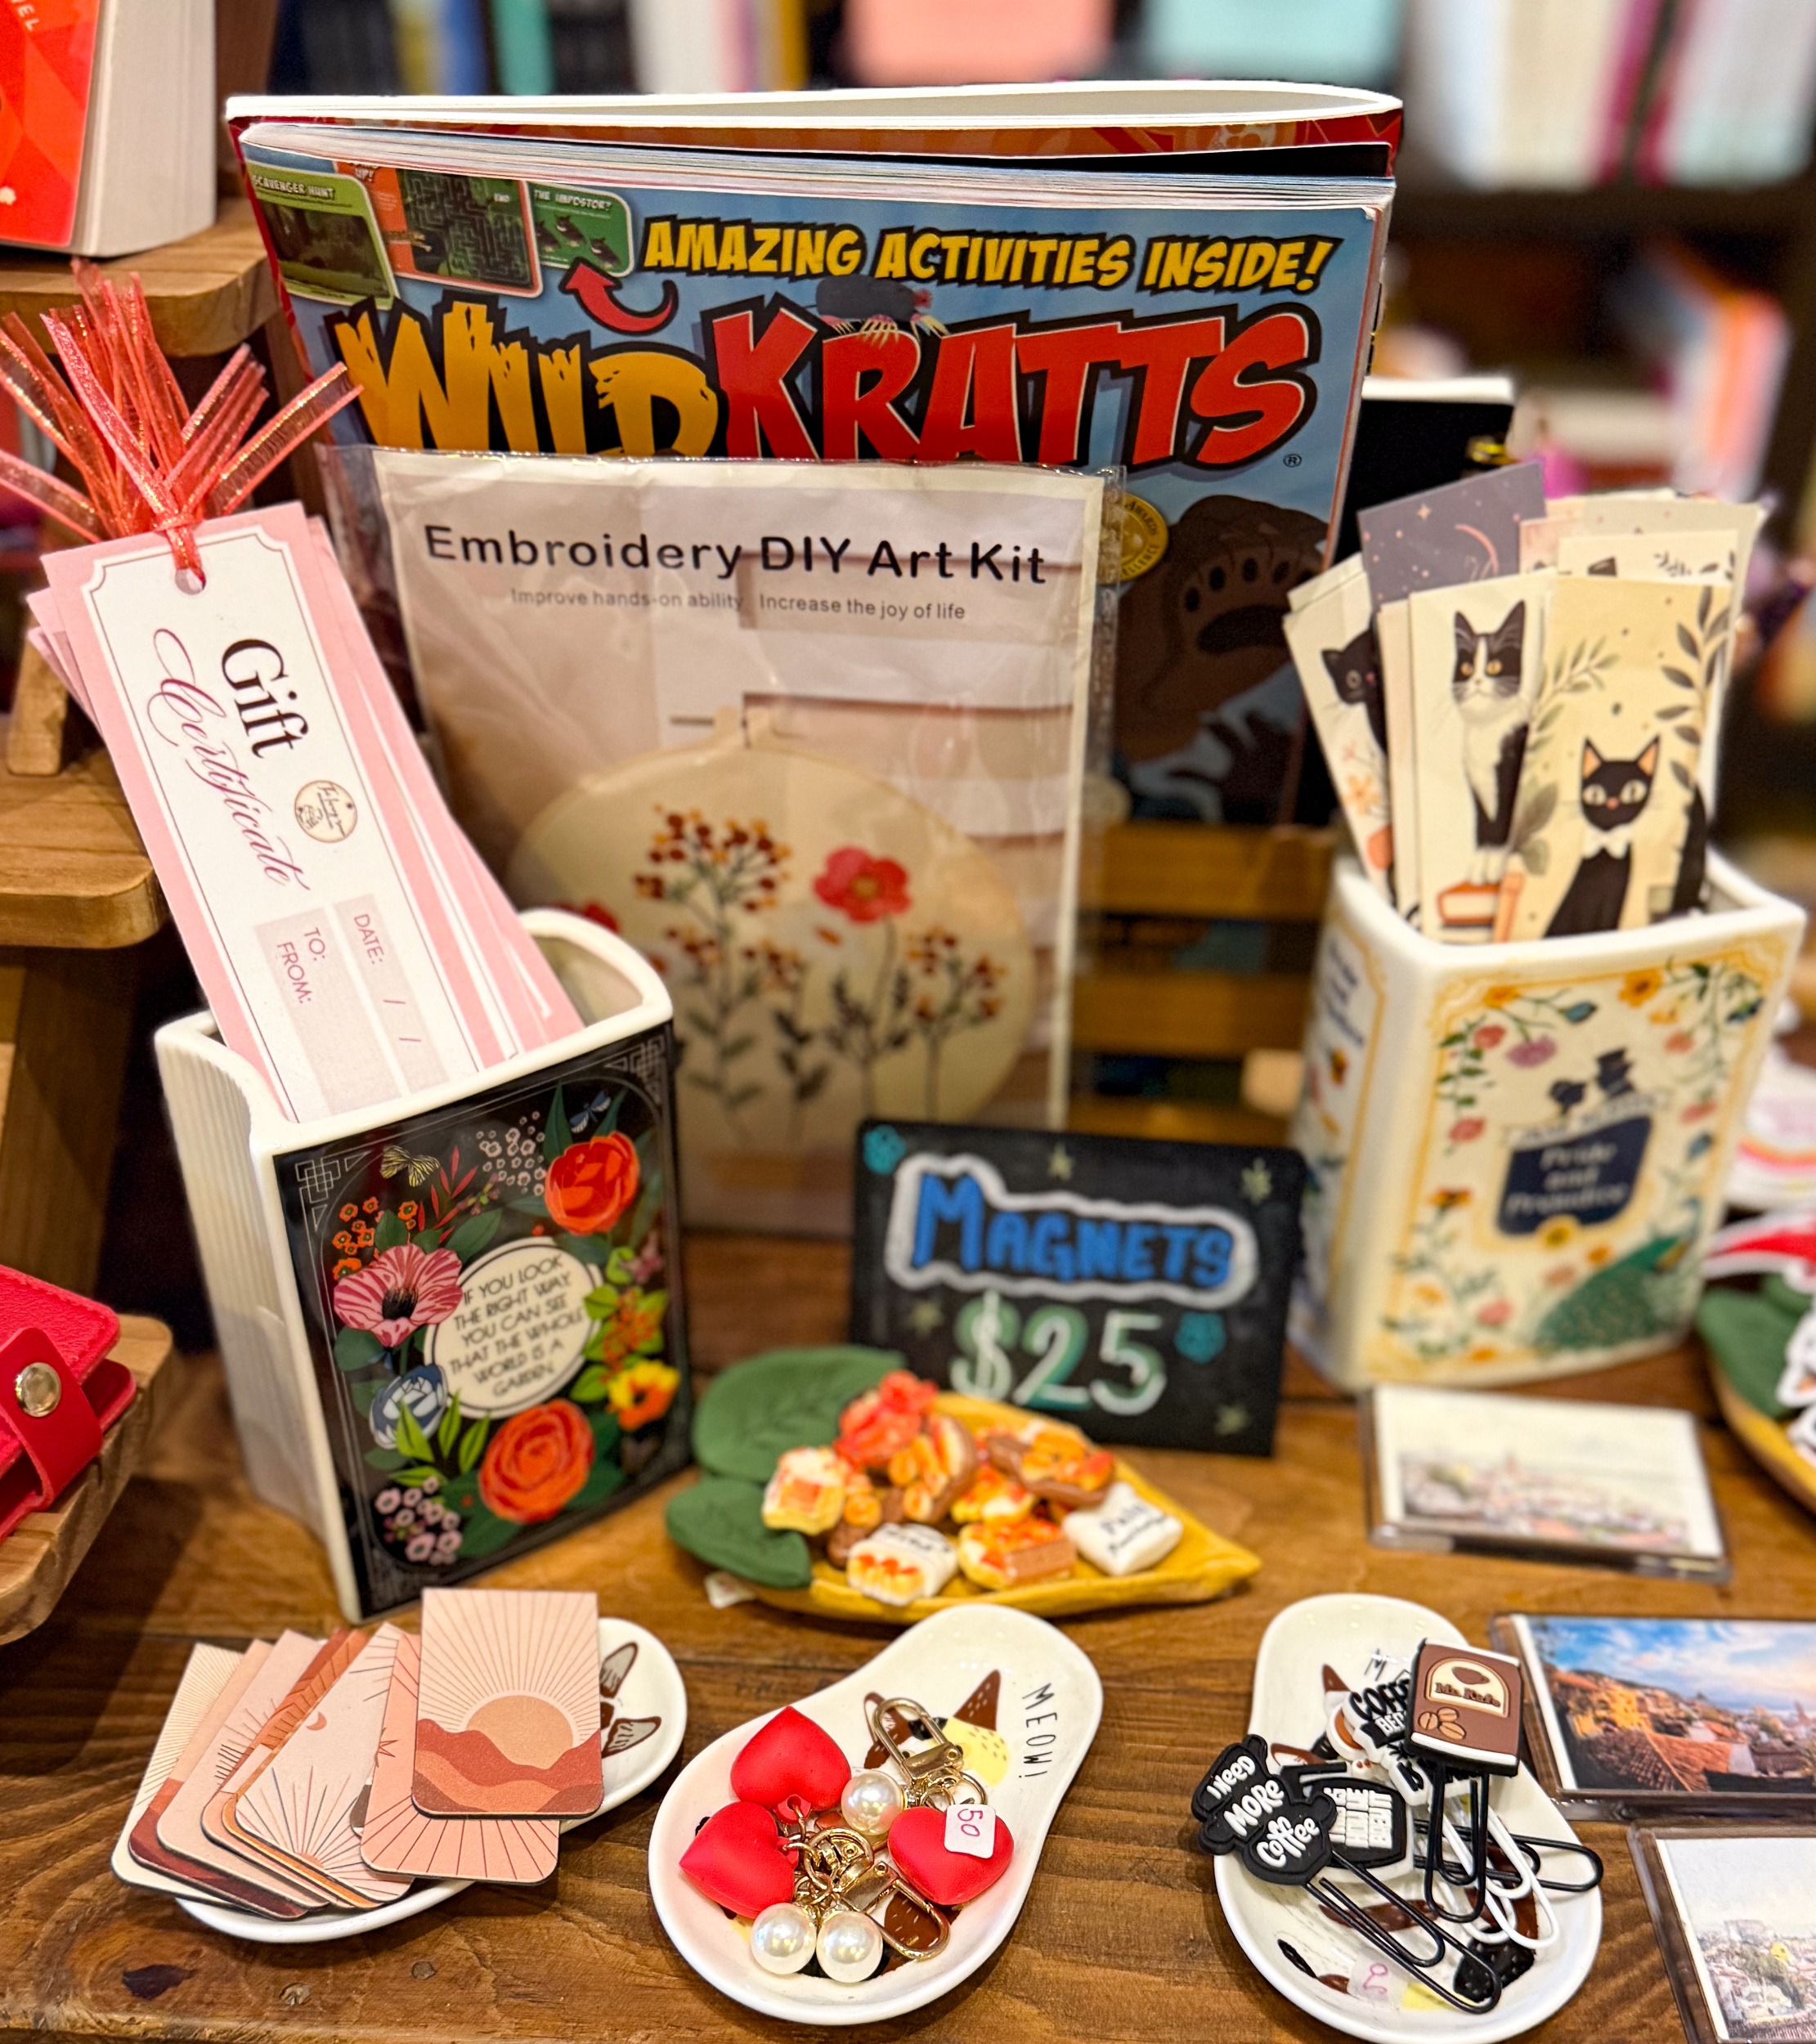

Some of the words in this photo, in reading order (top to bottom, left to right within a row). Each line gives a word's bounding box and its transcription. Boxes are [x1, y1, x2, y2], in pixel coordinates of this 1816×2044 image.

[11, 0, 39, 31] EL
[252, 174, 305, 195] SCAVENGER
[308, 186, 334, 199] HUNT
[534, 190, 550, 201] THE
[643, 220, 863, 277] AMAZING
[875, 230, 1129, 286] ACTIVITIES
[1144, 240, 1334, 293] INSIDE!
[334, 300, 719, 456] WILD
[712, 309, 1310, 464] KRATTS
[424, 524, 742, 580] Embroidery
[760, 536, 851, 573] DIY
[867, 540, 954, 579] Art
[970, 541, 1046, 584] Kit
[511, 589, 587, 610] Improve
[594, 591, 682, 608] hands-on
[688, 593, 743, 613] ability
[760, 594, 841, 613] Increase
[847, 598, 876, 615] the
[880, 601, 908, 621] joy
[914, 603, 932, 619] of
[936, 603, 966, 620] life
[222, 638, 309, 759] Gift
[147, 628, 311, 890] Certificate
[303, 926, 326, 961] TO:
[353, 913, 384, 965] DATE:
[276, 941, 313, 1004] FROM:
[911, 1172, 1235, 1289] MAGNETS
[454, 1308, 483, 1331] THE
[486, 1288, 528, 1316] RIGHT
[533, 1271, 572, 1297] WAY
[464, 1288, 474, 1306] IF
[478, 1274, 513, 1296] YOU
[518, 1254, 563, 1282] LOOK
[450, 1346, 489, 1375] THAT
[495, 1334, 521, 1356] THE
[525, 1311, 584, 1342] WHOLE
[462, 1324, 497, 1347] YOU
[501, 1307, 541, 1332] CAN
[546, 1293, 568, 1314] SEE
[473, 1353, 528, 1385] WORLD
[531, 1344, 545, 1360] IS
[550, 1338, 564, 1354] A
[949, 1290, 1168, 1416] $25
[491, 1364, 554, 1397] GARDEN
[1348, 1679, 1410, 1721] COFF
[1017, 1681, 1058, 1779] MEOW!
[1206, 1785, 1222, 1800] I
[957, 1807, 984, 1839] 50
[1256, 1816, 1321, 1868] Coffee
